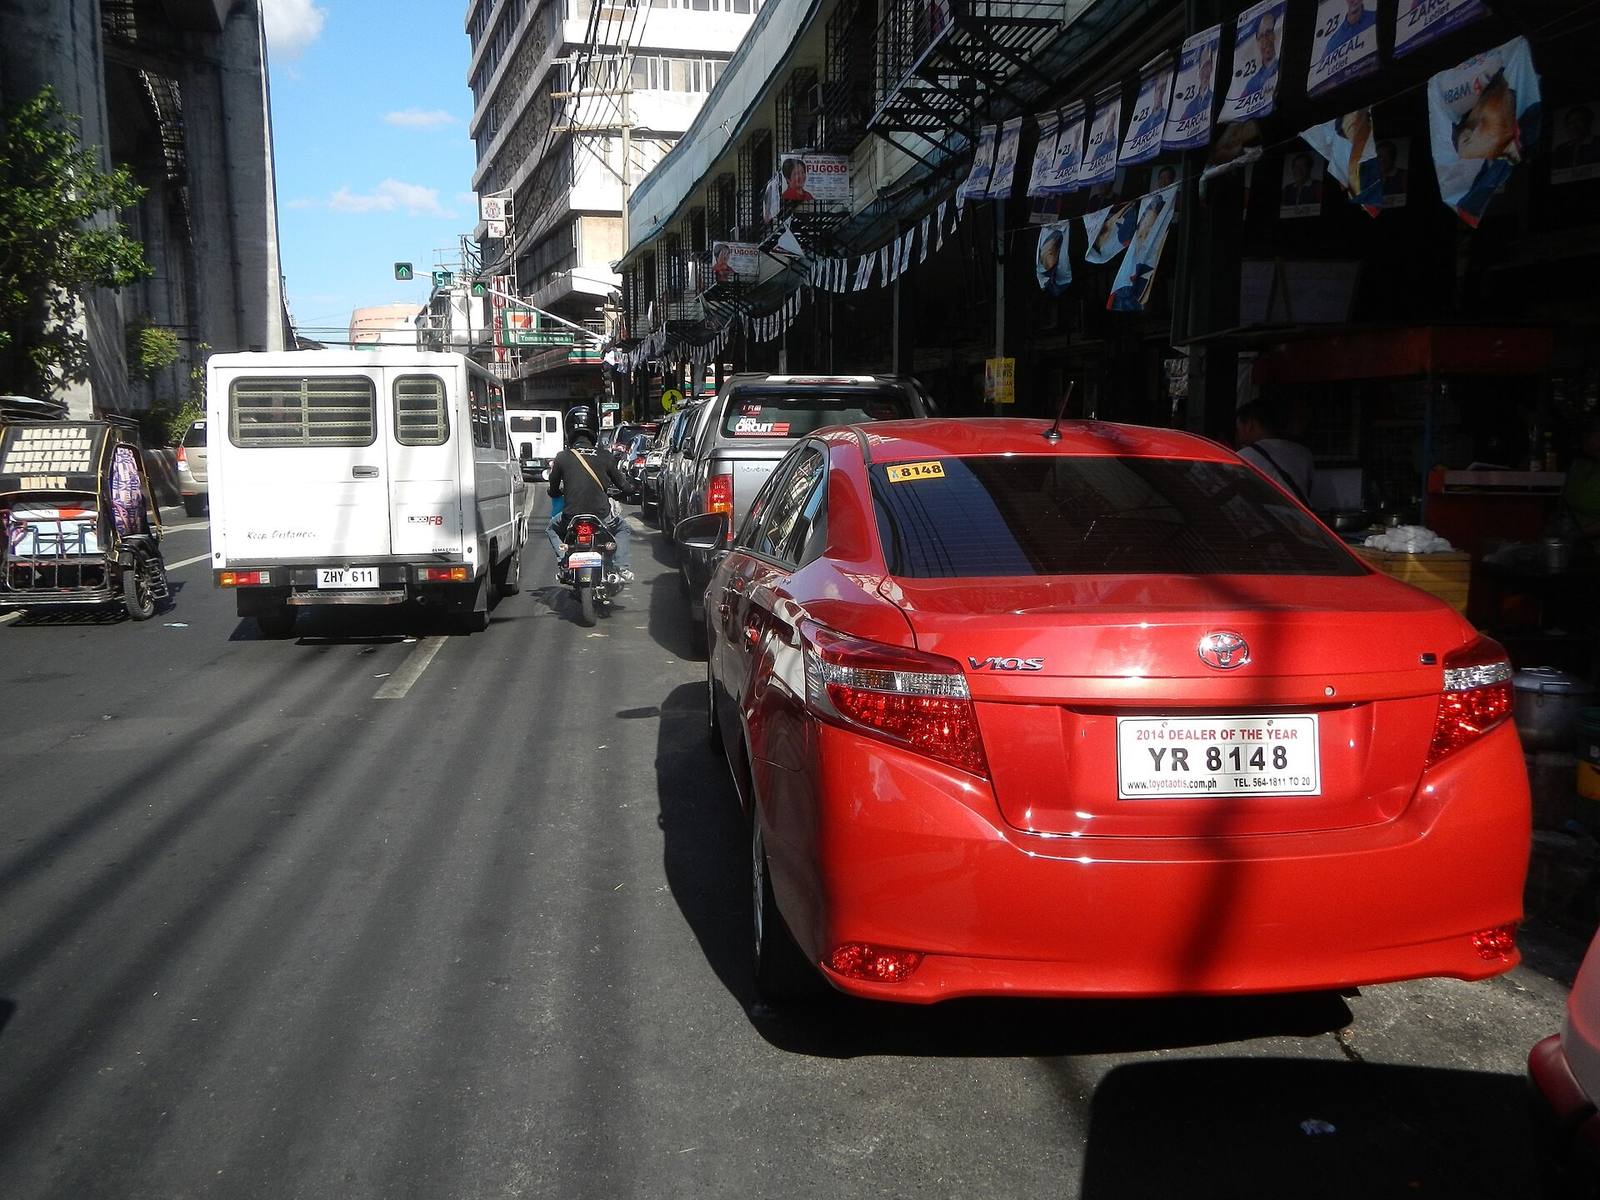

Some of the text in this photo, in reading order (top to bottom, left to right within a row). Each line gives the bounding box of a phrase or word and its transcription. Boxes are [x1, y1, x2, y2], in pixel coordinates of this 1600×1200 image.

[1325, 14, 1340, 37] 23
[1243, 60, 1256, 77] 23
[1184, 85, 1195, 100] 23
[1138, 107, 1149, 121] 23
[1094, 133, 1103, 144] 23
[806, 164, 847, 173] FUGOSO
[735, 422, 773, 433] CIRCUIT
[900, 464, 942, 477] 8148
[429, 515, 443, 525] FB
[323, 571, 373, 583] ZHY 611
[967, 656, 1046, 671] VIOS
[1136, 728, 1298, 741] 2014 DEALER OF THE YEAR
[1148, 745, 1288, 772] YR 8148
[1127, 777, 1310, 791] www.toyotaotis.com.ph TEL. 564-1811 TO 20
